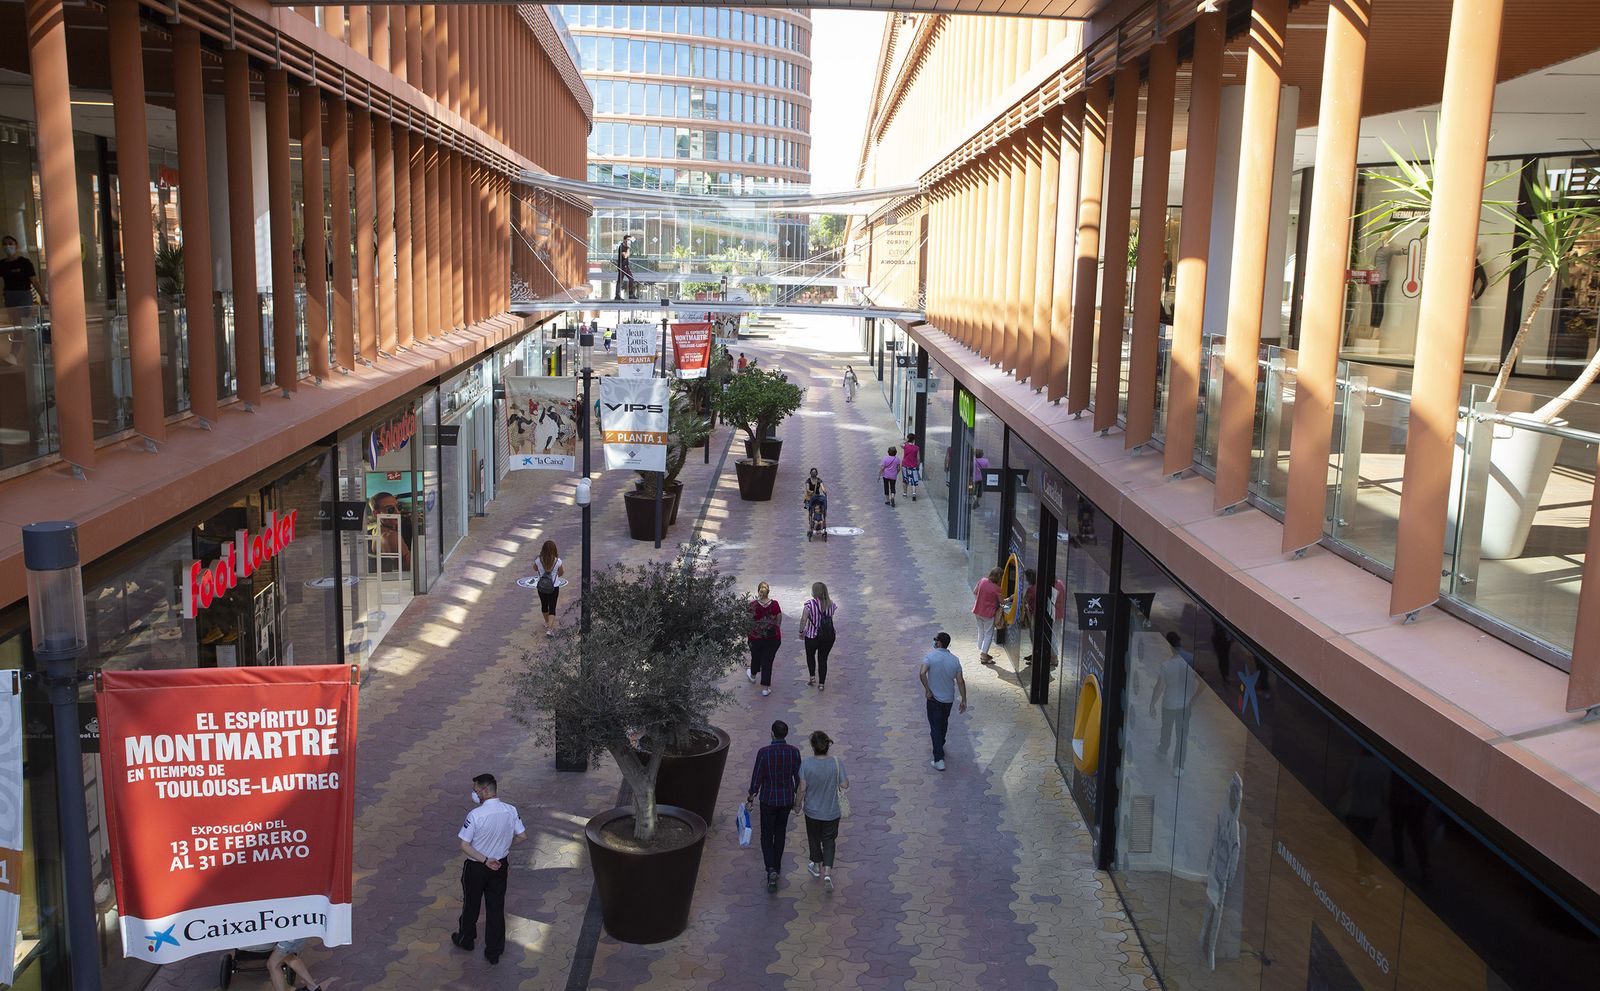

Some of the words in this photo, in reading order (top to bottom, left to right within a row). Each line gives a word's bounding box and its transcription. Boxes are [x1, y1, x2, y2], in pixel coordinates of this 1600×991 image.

[628, 337, 648, 345] Louis
[628, 345, 648, 354] David
[604, 403, 663, 413] VIPS
[618, 433, 654, 442] PLANTA
[657, 436, 663, 444] 1
[190, 542, 237, 618] Foot
[242, 508, 297, 578] Locker
[196, 713, 219, 730] EL
[224, 708, 309, 730] ESPÍRITU
[315, 708, 337, 726] DE
[125, 728, 339, 766] MONTMARTRE
[127, 768, 144, 783] EN
[148, 764, 205, 779] TIEMPOS
[208, 764, 225, 776] DE
[155, 772, 339, 799] TOULOUSE-LAUTREC
[191, 821, 262, 836] EXPOSICIÓN
[266, 820, 287, 830] DEL
[170, 840, 188, 856] 13
[194, 838, 219, 852] DE
[225, 829, 307, 849] FEBRERO
[170, 856, 194, 872] AL
[199, 856, 216, 870] 31
[222, 851, 247, 866] DE
[252, 845, 310, 862] MAYO
[1278, 841, 1312, 888] SAMSUNG
[1313, 880, 1341, 923] Galaxy
[1341, 912, 1356, 936] S20
[1355, 926, 1376, 960] Ultra
[1375, 952, 1390, 974] 5G
